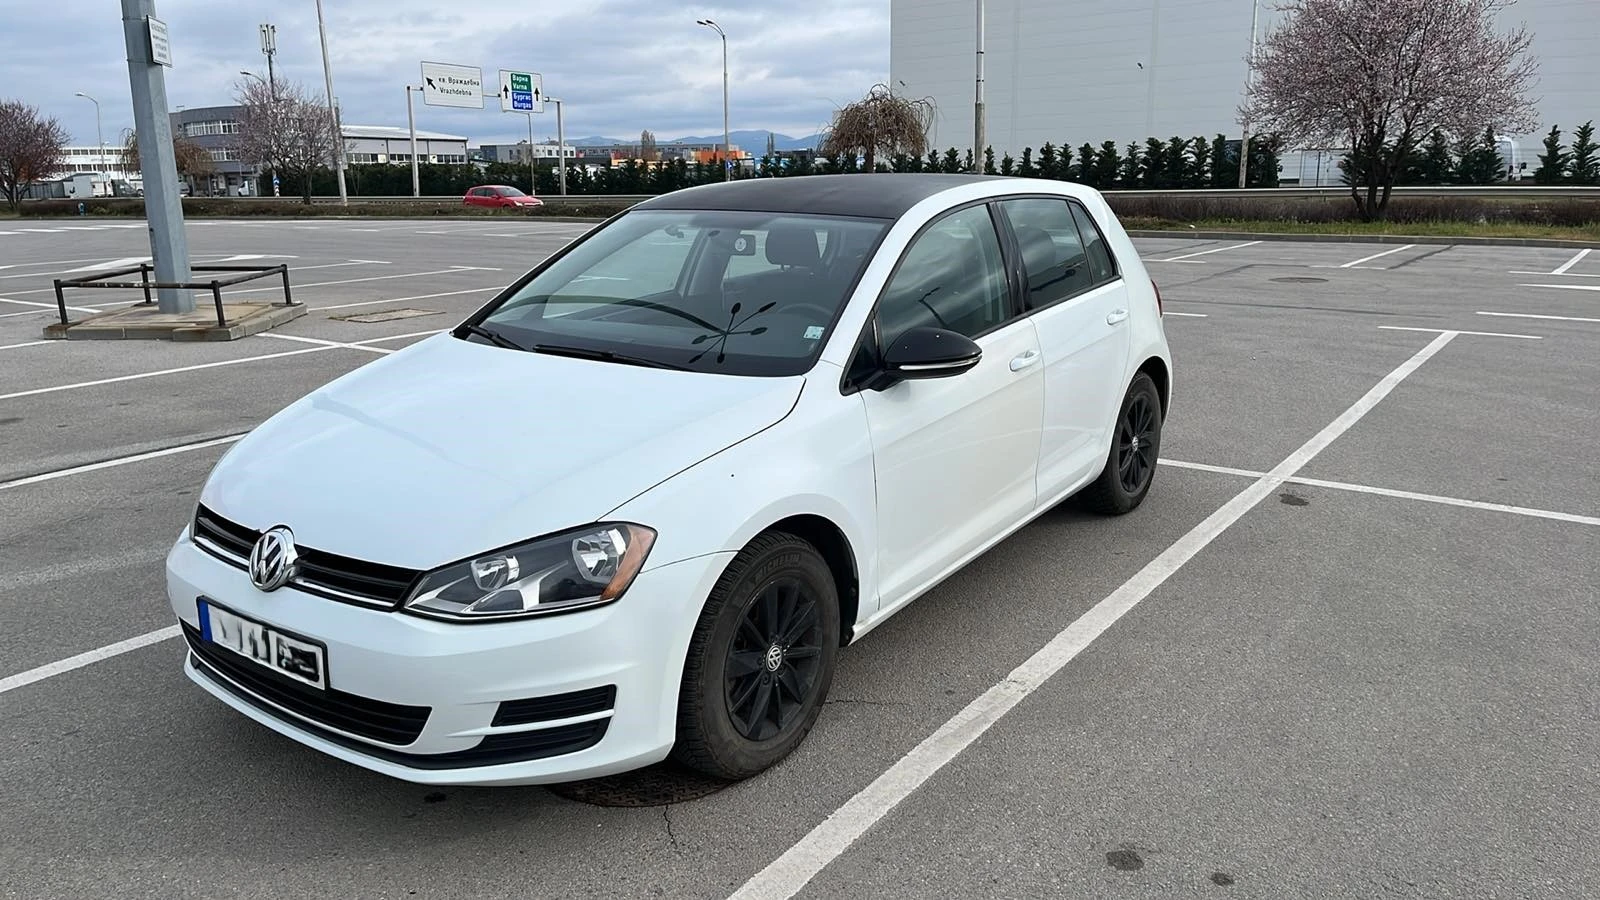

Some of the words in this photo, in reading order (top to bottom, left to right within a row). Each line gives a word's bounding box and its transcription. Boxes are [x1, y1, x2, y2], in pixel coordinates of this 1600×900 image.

[448, 76, 480, 86] Враждебна
[512, 74, 529, 82] Варна
[512, 82, 528, 90] Varna
[439, 87, 472, 96] Vrazhdebna
[513, 92, 532, 101] Бургас
[513, 101, 532, 109] Burgas
